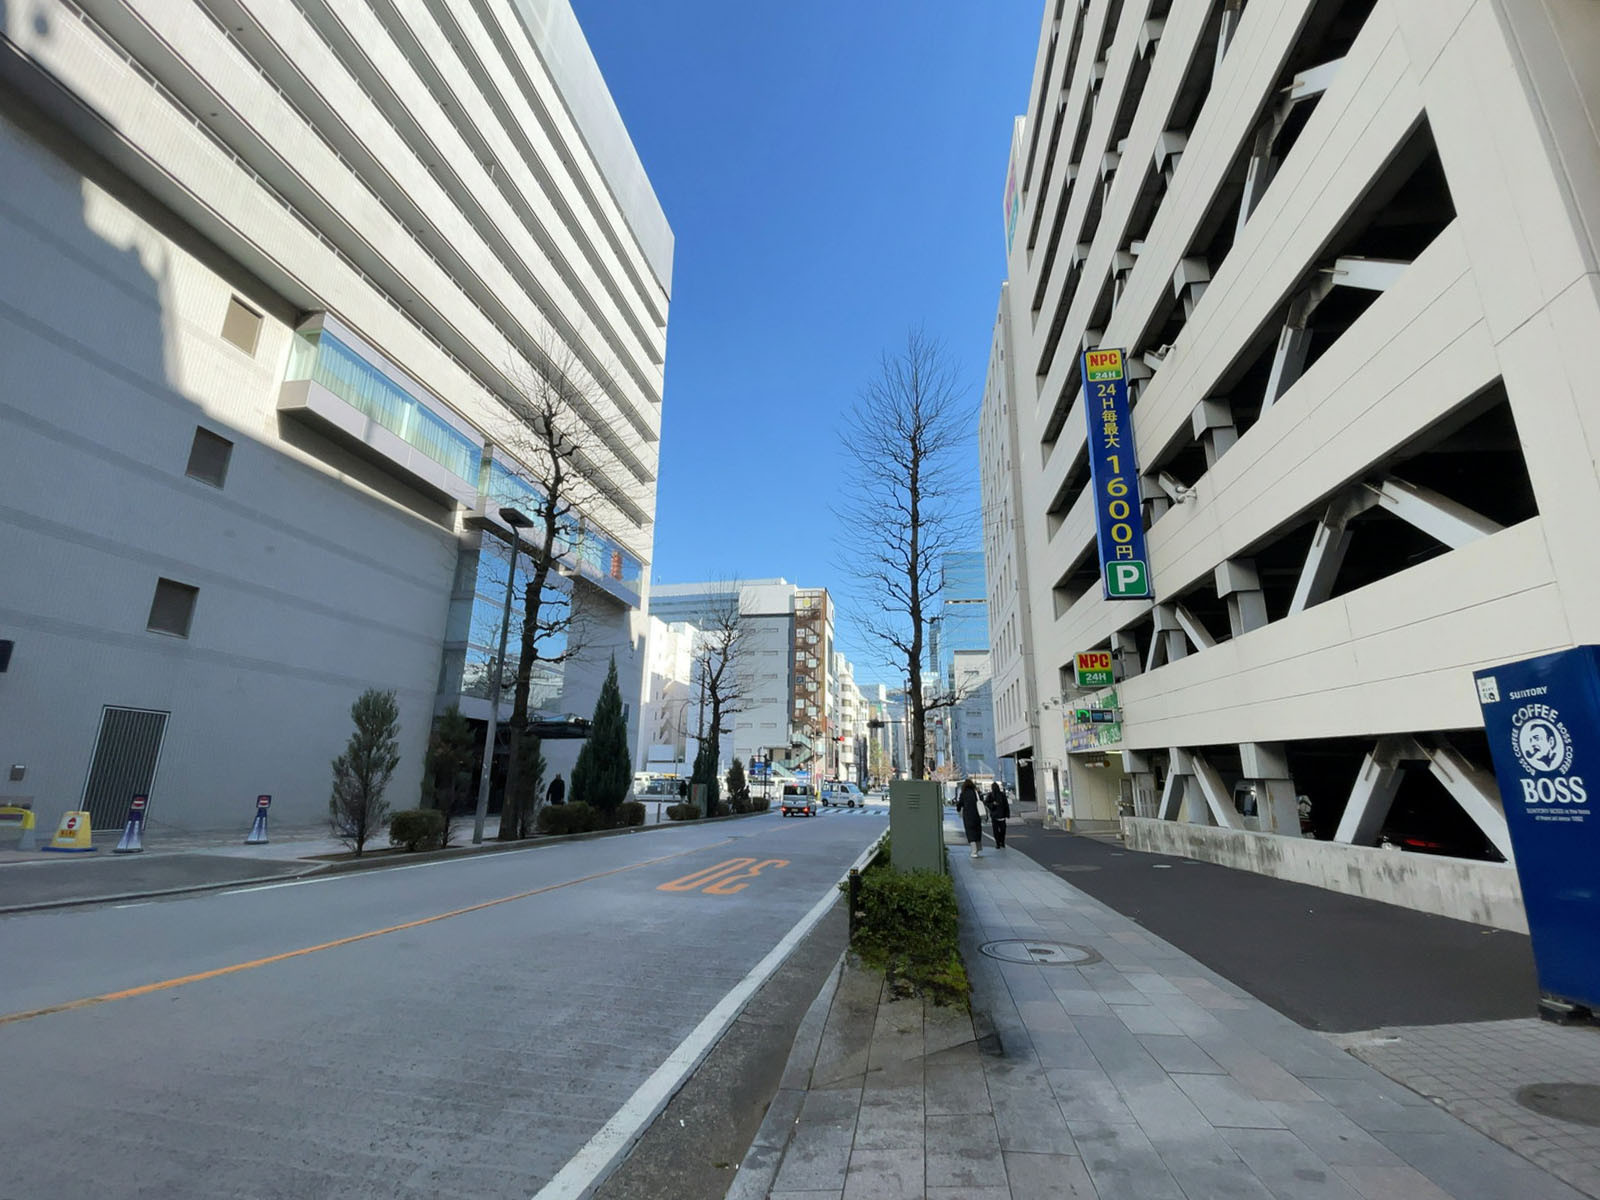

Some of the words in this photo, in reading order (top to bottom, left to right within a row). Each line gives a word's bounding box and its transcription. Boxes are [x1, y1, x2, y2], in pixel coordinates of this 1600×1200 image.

[1090, 353, 1117, 366] NPC
[1095, 371, 1116, 379] 24H
[1116, 565, 1139, 592] P
[1078, 653, 1109, 669] NPC
[1086, 672, 1107, 681] 24H
[1512, 703, 1559, 727] COFFEE
[1556, 721, 1572, 744] BOSS
[1520, 776, 1587, 803] BOSS
